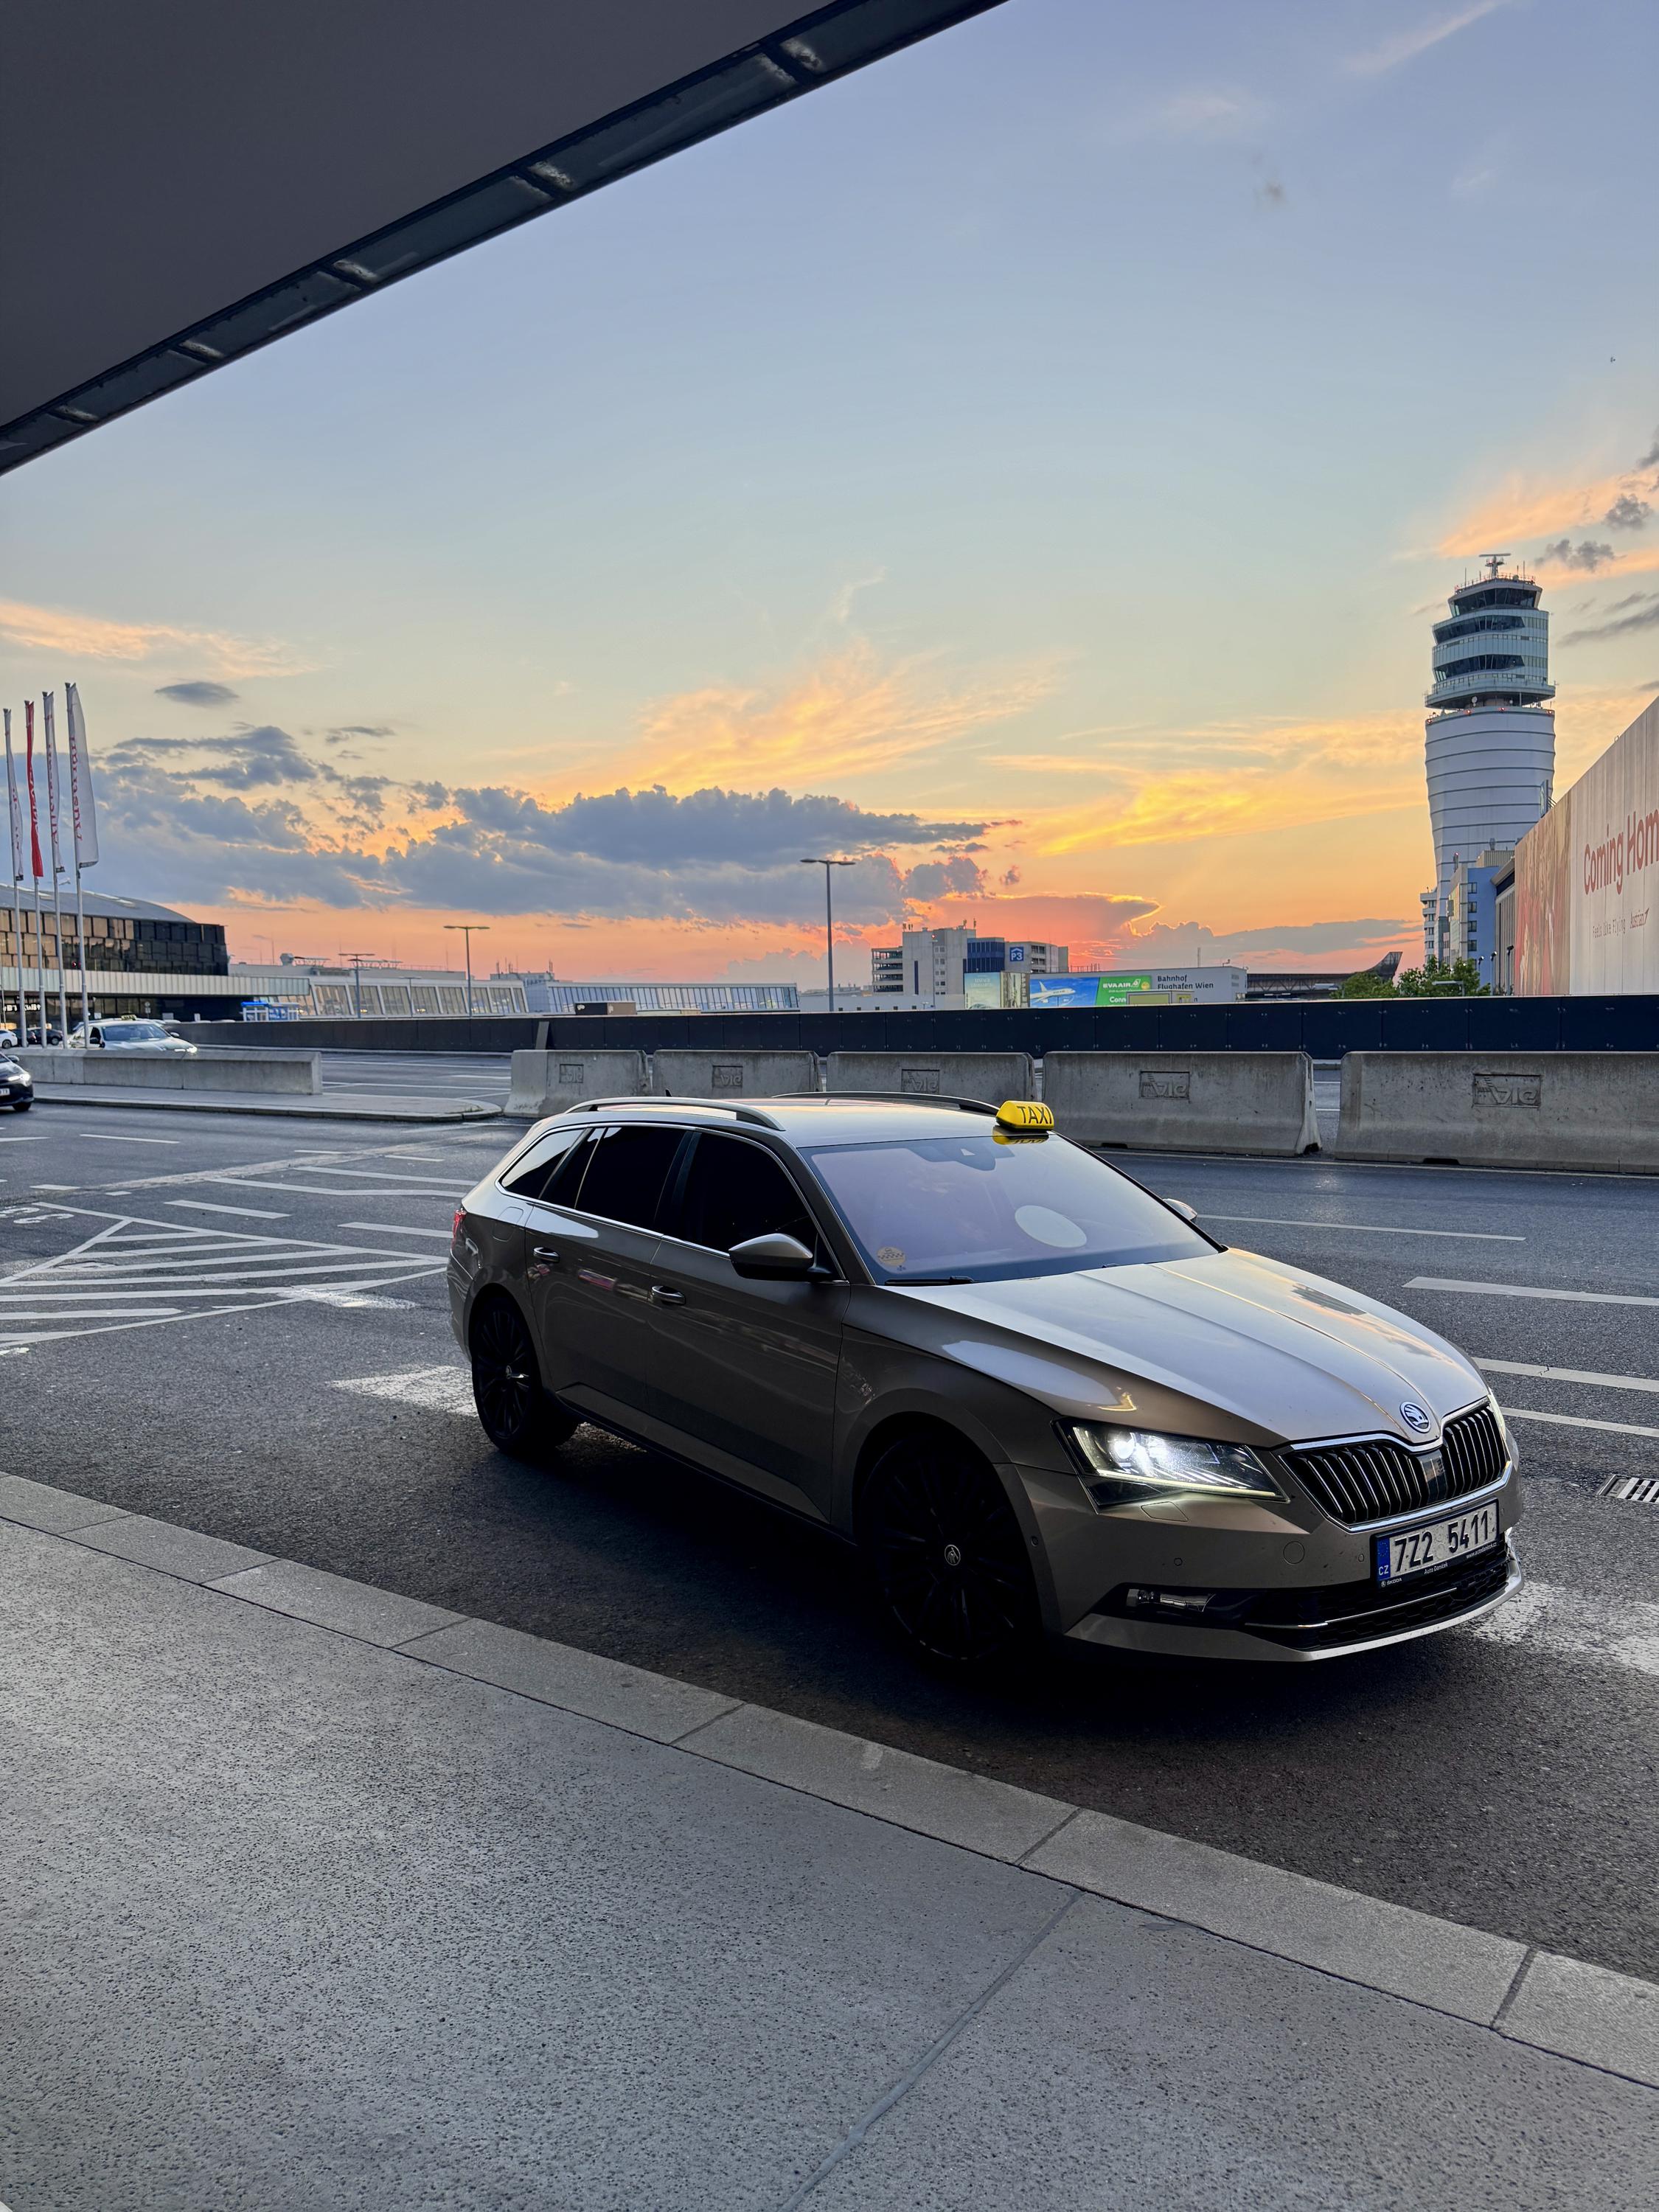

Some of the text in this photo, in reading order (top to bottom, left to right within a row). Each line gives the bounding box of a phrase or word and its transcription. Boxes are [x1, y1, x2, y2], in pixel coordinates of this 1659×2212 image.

[1584, 823, 1623, 894] Coming
[1011, 952, 1023, 960] P3
[1158, 975, 1187, 983] Bahnhof
[1016, 1106, 1052, 1124] TAXI
[1395, 1510, 1488, 1573] 7Z2 5411
[1378, 1565, 1389, 1576] CZ
